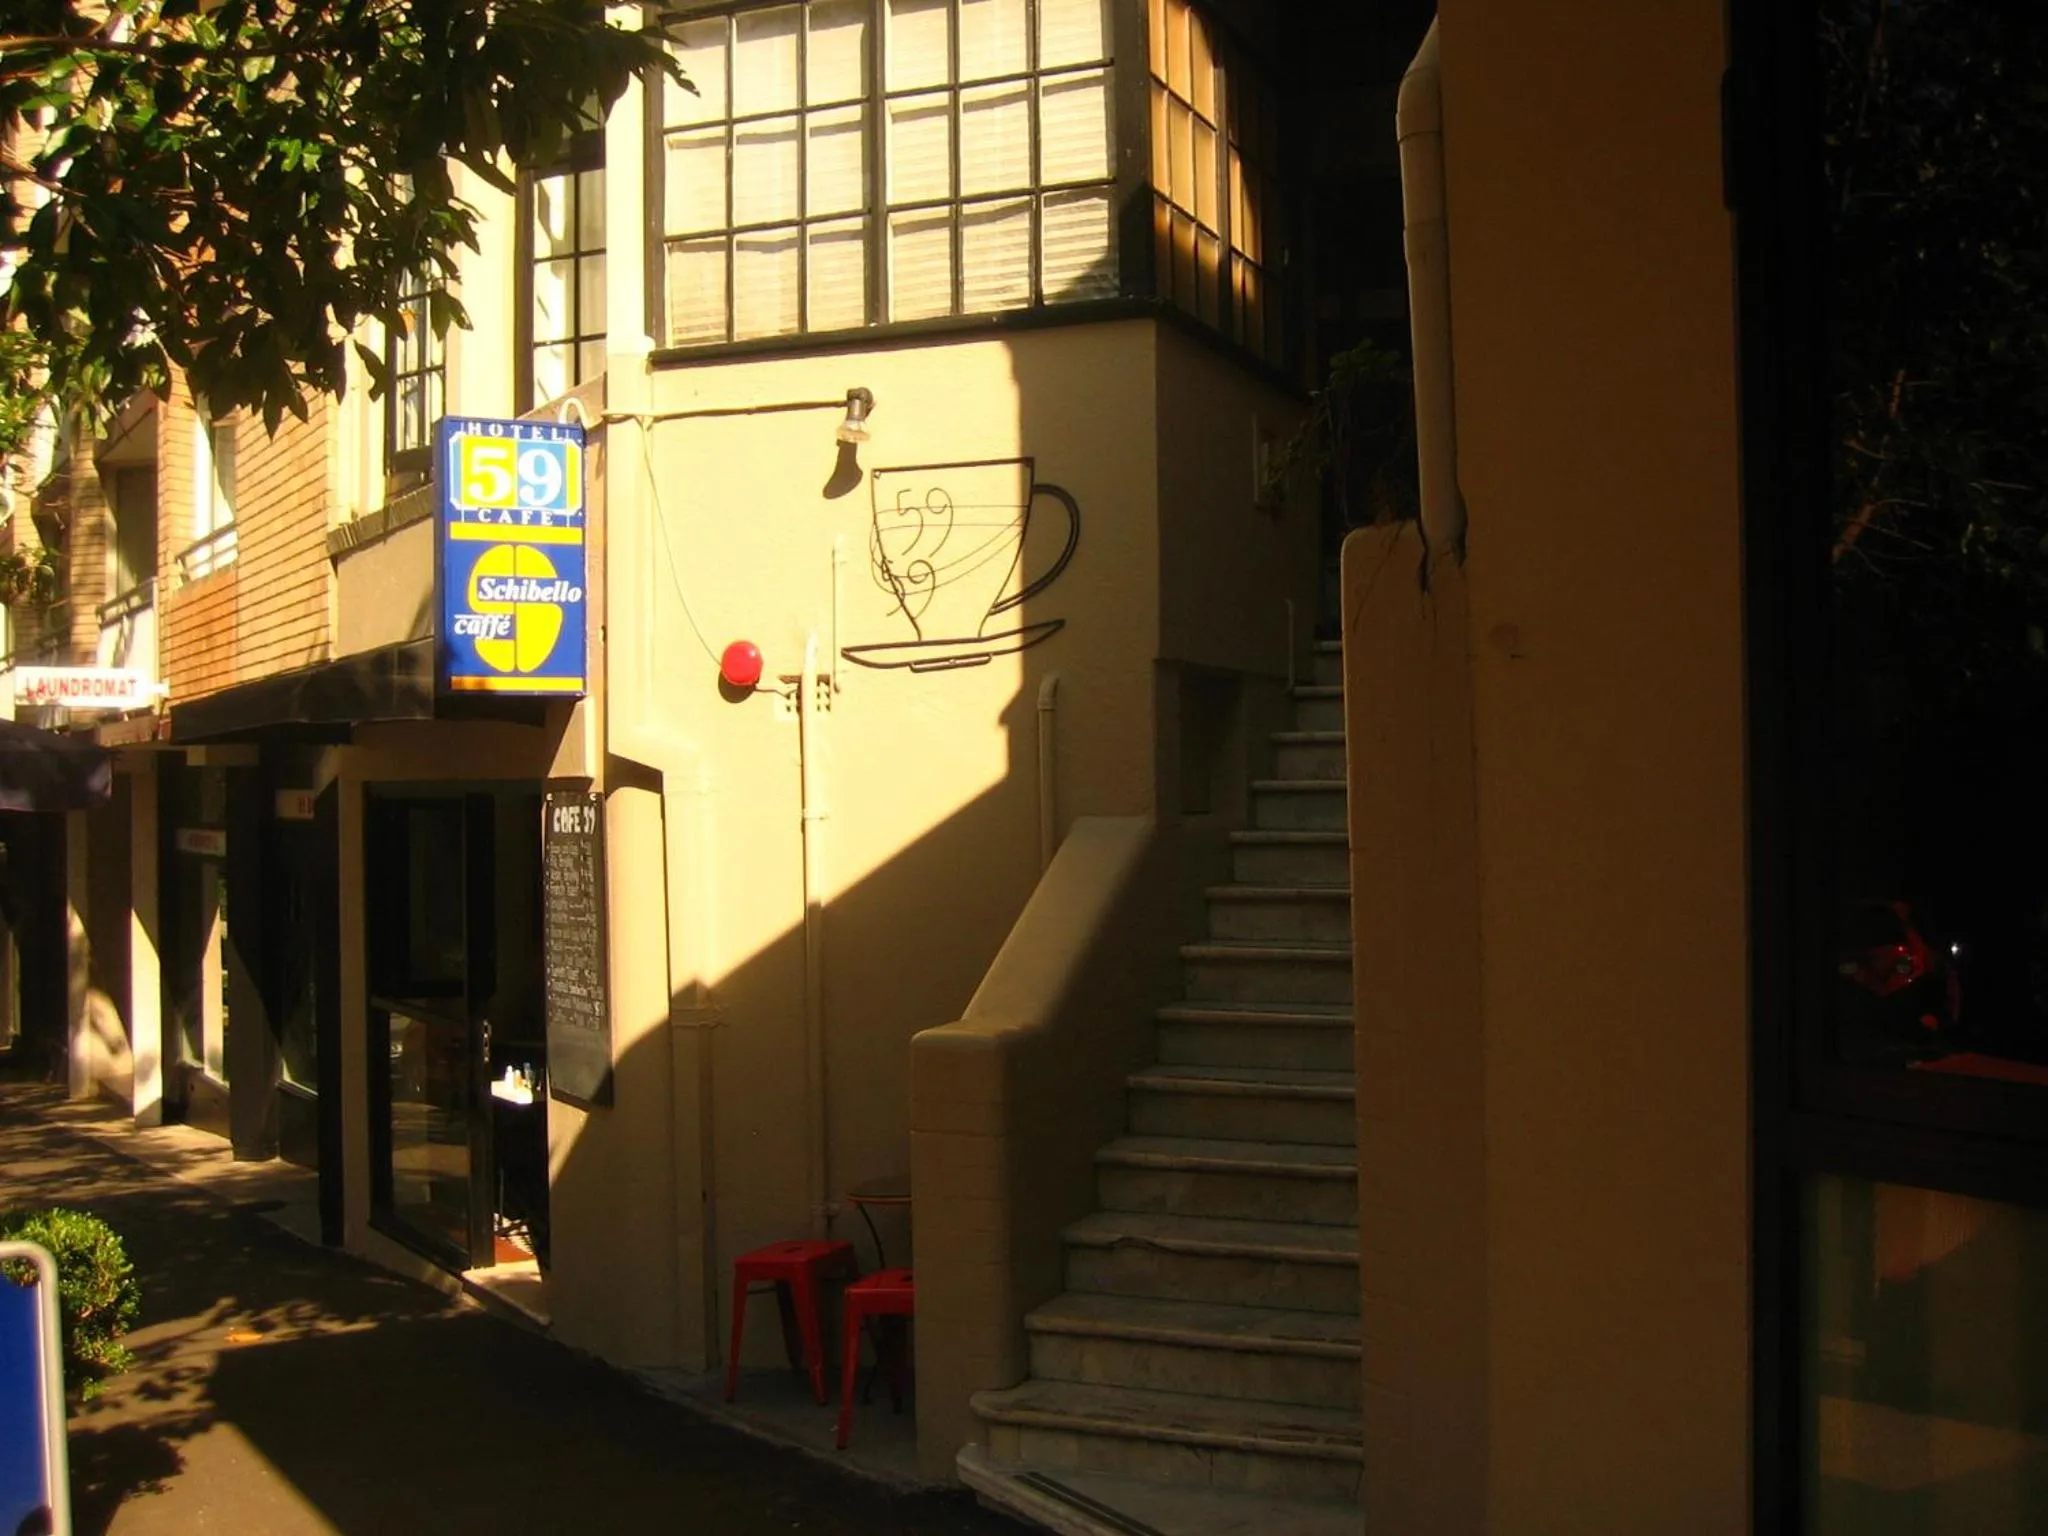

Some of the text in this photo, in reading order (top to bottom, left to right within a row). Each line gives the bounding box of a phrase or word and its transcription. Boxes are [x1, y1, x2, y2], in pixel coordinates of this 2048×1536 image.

[468, 422, 562, 440] HOTEL
[469, 447, 561, 506] 59
[478, 509, 553, 525] CAFE
[478, 577, 582, 604] Schibello
[26, 679, 136, 698] LAUNDROMAT
